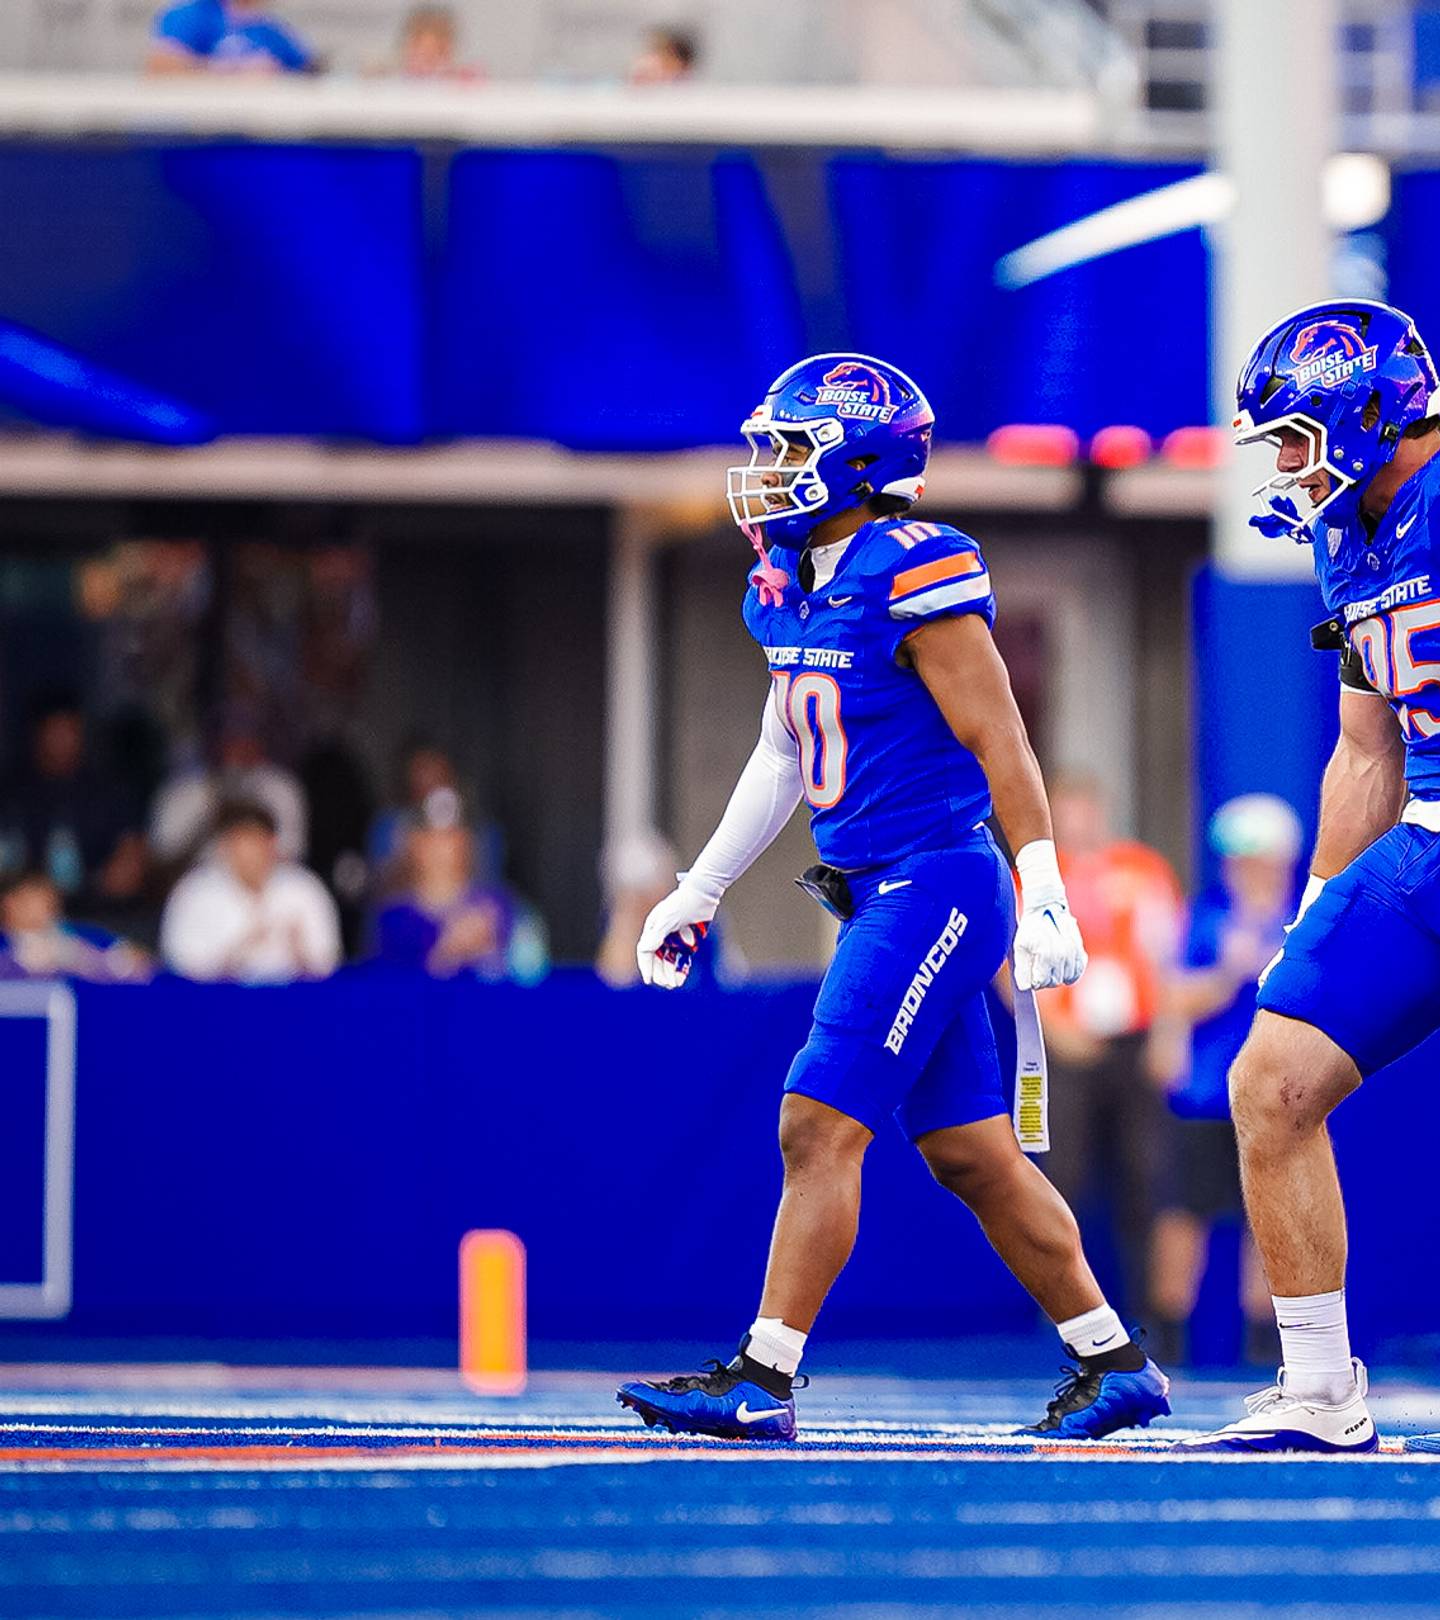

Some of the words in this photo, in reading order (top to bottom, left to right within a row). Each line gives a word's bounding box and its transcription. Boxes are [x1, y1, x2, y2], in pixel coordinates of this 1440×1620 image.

[1300, 349, 1345, 384] BOISE
[1325, 352, 1373, 383] STATE
[820, 390, 871, 403] BOISE
[841, 402, 891, 419] STATE
[1381, 575, 1432, 608] STATE
[803, 648, 854, 668] STATE
[884, 906, 969, 1055] BRONCOS
